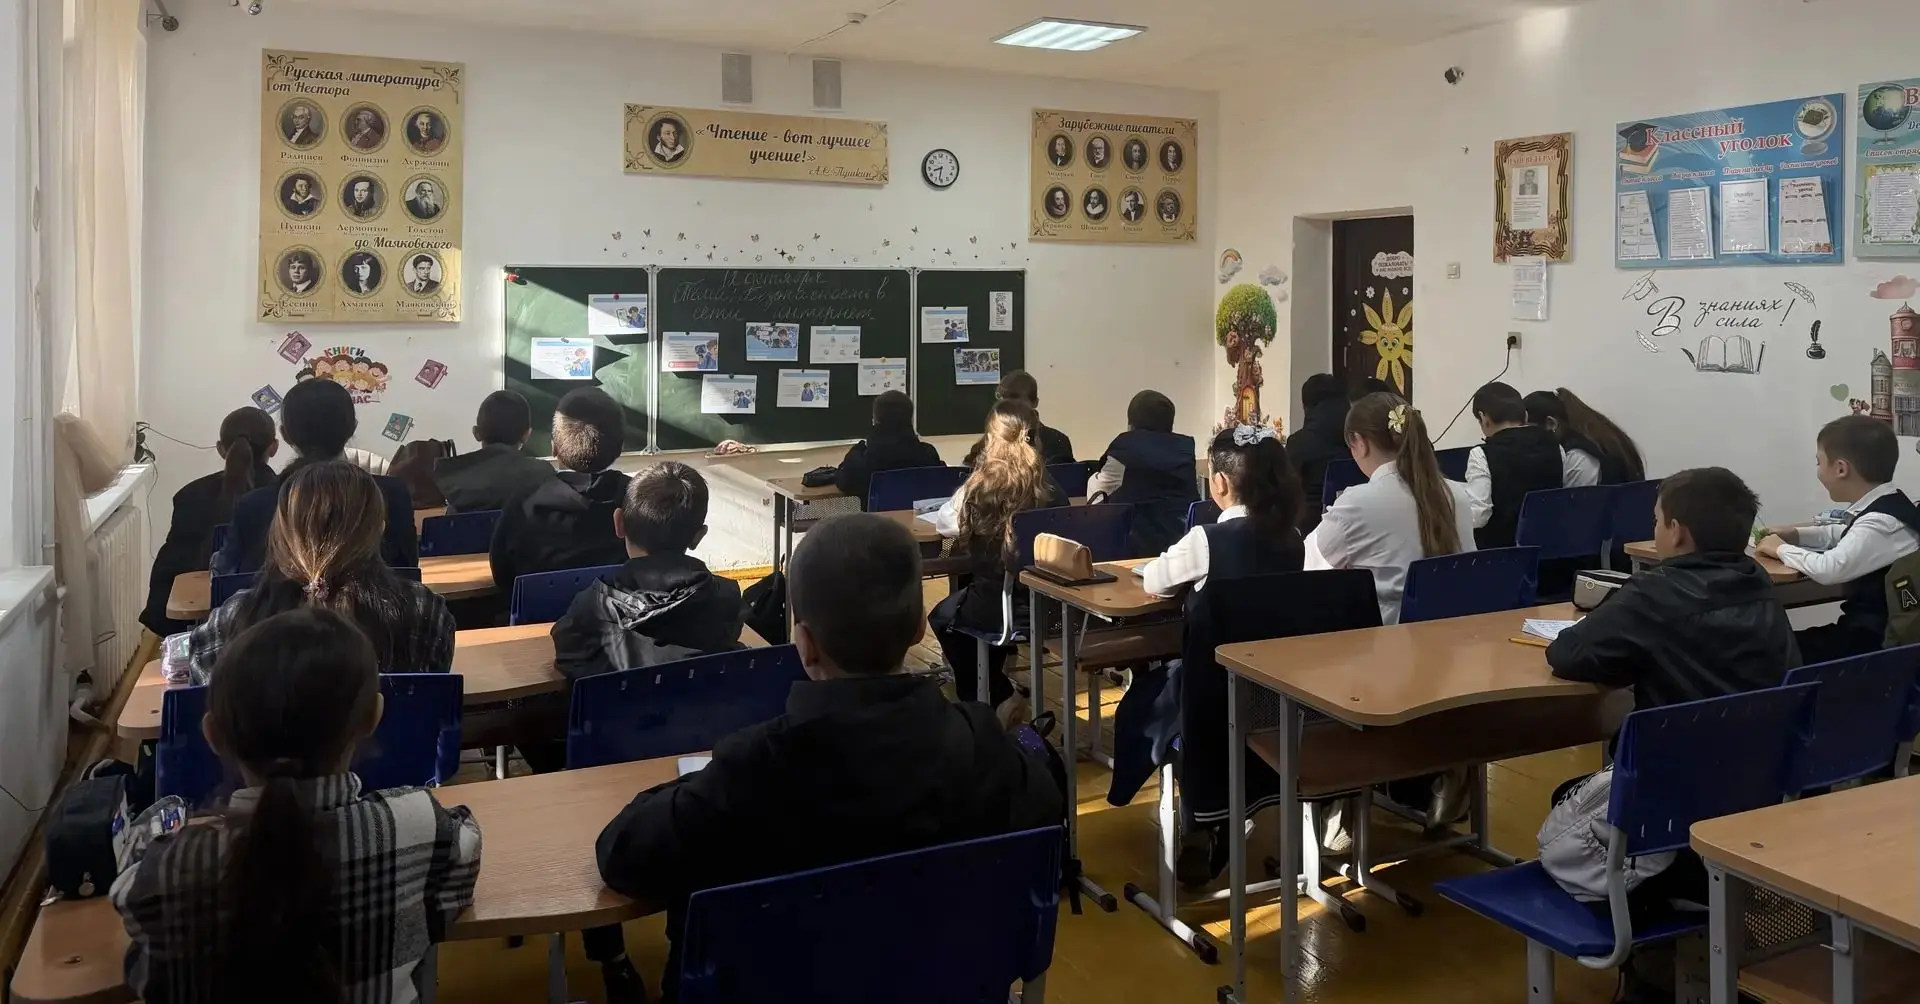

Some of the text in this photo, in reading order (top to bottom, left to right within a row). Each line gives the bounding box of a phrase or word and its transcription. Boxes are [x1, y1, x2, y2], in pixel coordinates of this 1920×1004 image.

[283, 64, 440, 89] Русская литература
[273, 81, 351, 97] от Нестора
[1058, 117, 1176, 135] Зарубежные писатели
[1645, 118, 1745, 145] Классный
[783, 129, 813, 145] вот
[816, 136, 872, 150] лучшее
[1718, 134, 1792, 159] уголок
[355, 237, 452, 250] до Маяковского
[1647, 296, 1685, 336] В
[1716, 315, 1763, 328] сила
[324, 346, 365, 358] КНИГИ
